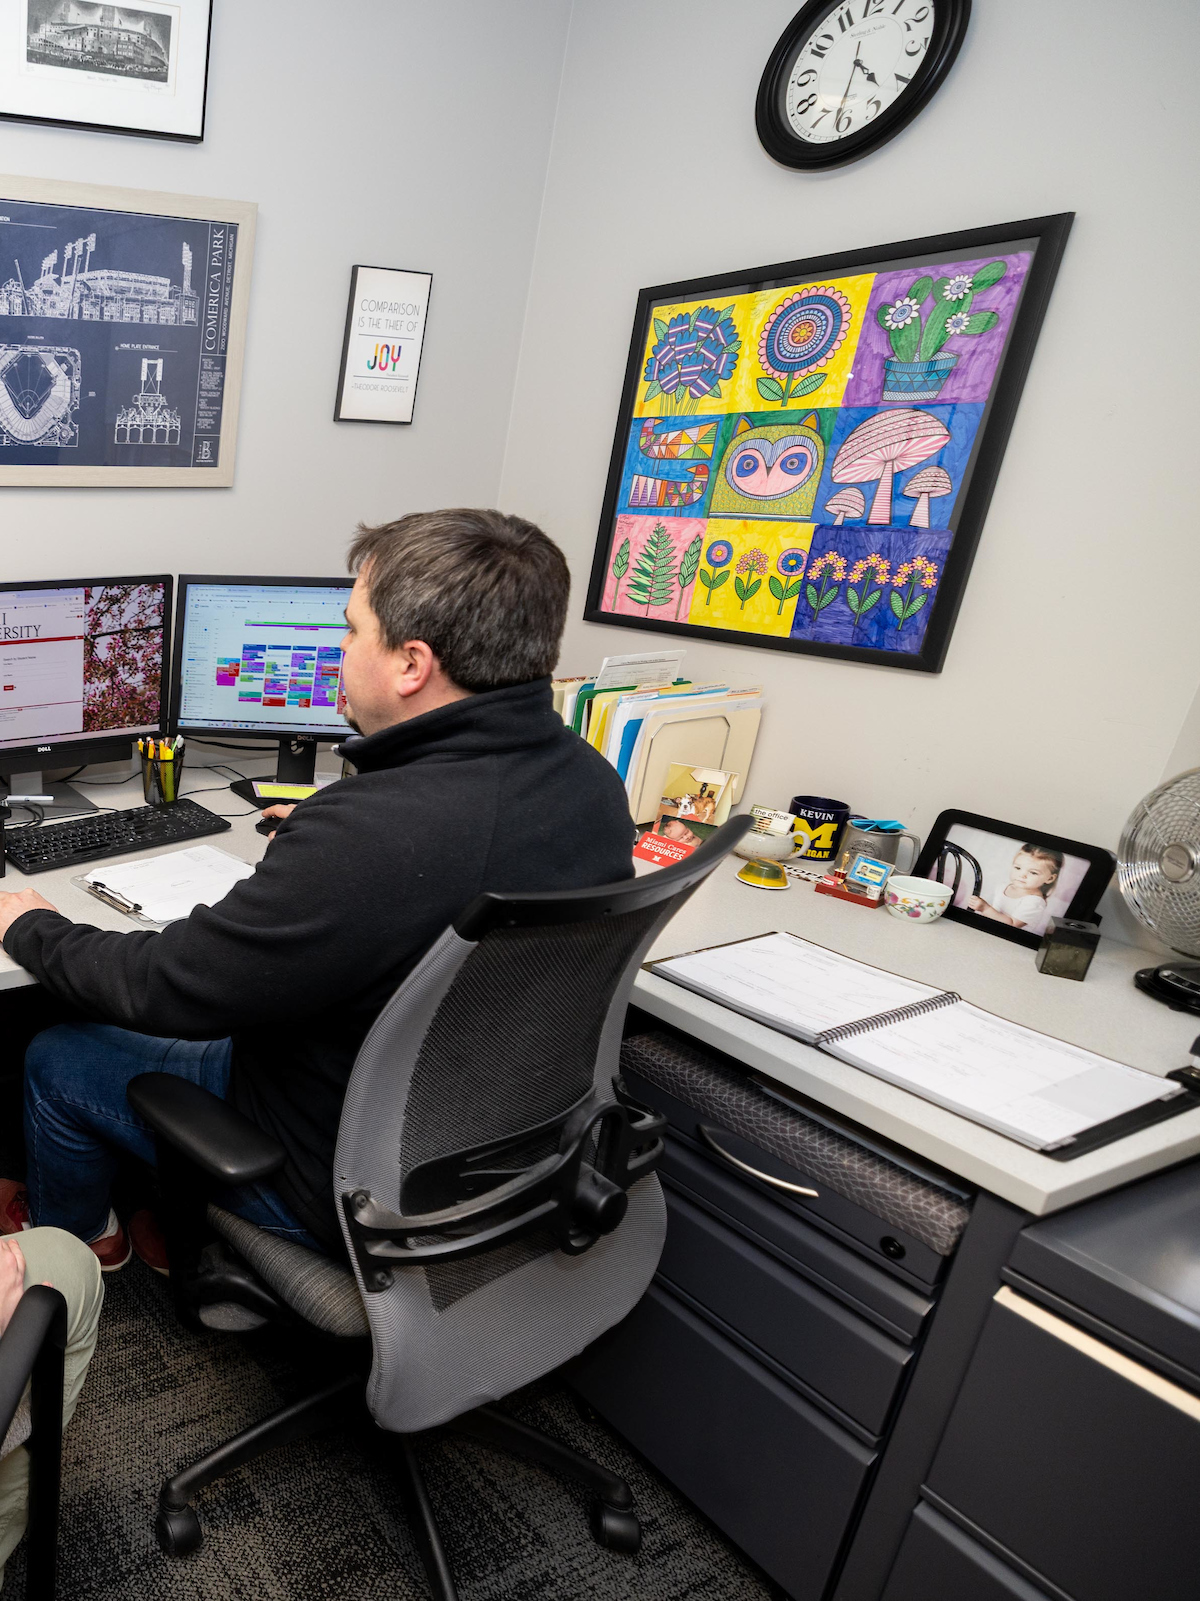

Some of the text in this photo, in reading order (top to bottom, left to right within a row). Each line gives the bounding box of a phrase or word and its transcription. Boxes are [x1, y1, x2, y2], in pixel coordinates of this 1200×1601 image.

[837, 8, 856, 34] 11
[904, 6, 930, 32] 2
[810, 33, 835, 59] 10
[905, 37, 930, 57] 3
[796, 68, 818, 88] 9
[894, 72, 912, 93] 4
[796, 93, 819, 115] 8
[865, 94, 882, 121] 5
[810, 107, 833, 129] 7
[835, 109, 853, 133] 6
[211, 229, 225, 267] PARK
[204, 272, 222, 351] COMERICA
[360, 298, 421, 317] COMPARISON
[358, 316, 419, 332] IS THE THIEF OF
[367, 343, 402, 371] JOY
[380, 384, 409, 393] ROOSEVELT
[767, 812, 789, 821] office
[800, 808, 835, 821] KEVIN
[793, 816, 839, 849] M
[641, 841, 684, 860] RESOURCES
[645, 836, 687, 855] Miami Cares
